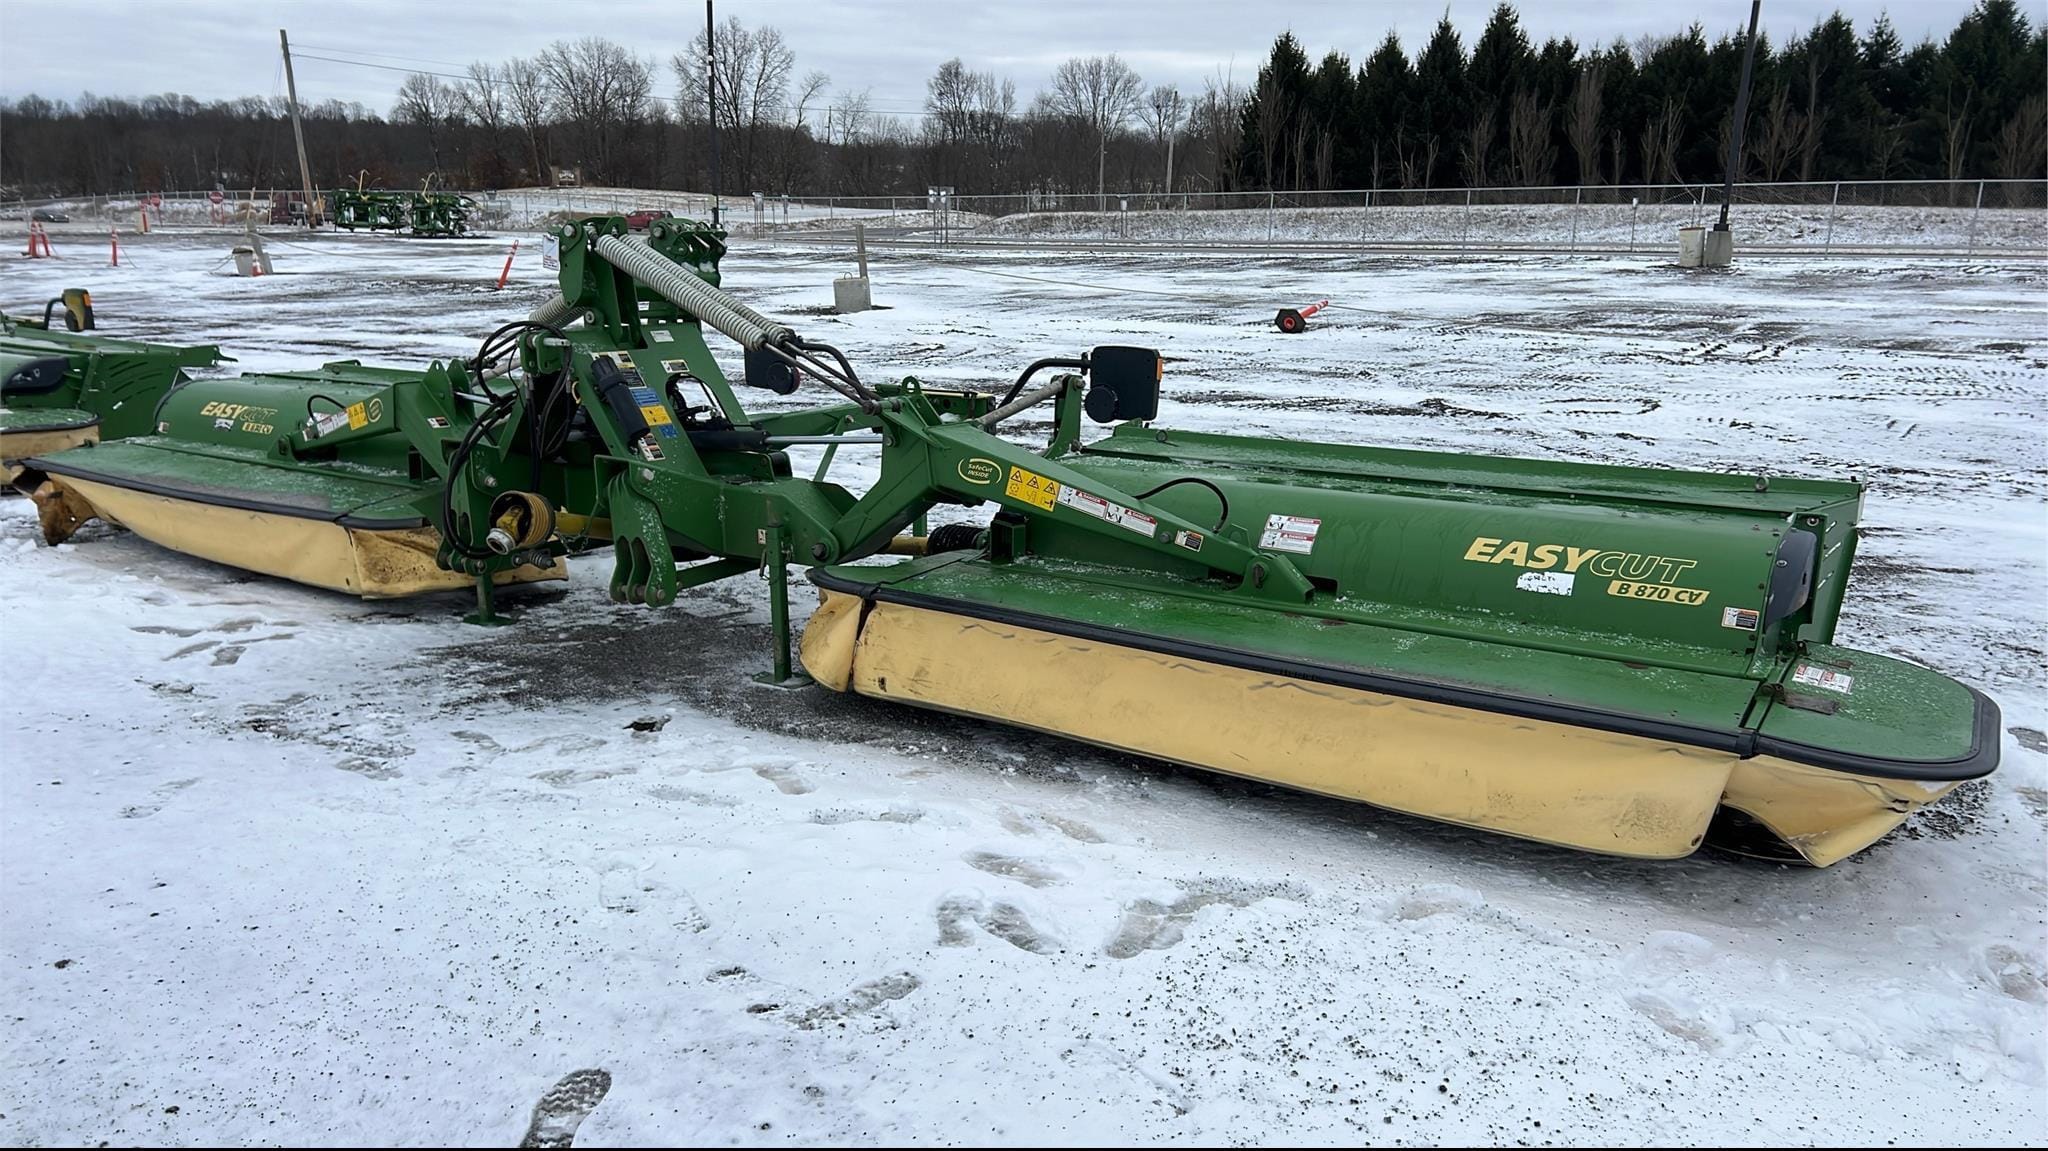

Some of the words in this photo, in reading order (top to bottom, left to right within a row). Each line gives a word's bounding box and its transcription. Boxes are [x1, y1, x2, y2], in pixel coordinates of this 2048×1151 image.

[1464, 537, 1697, 585] EASYCUT
[1616, 583, 1632, 595] B
[1634, 585, 1671, 600] 870
